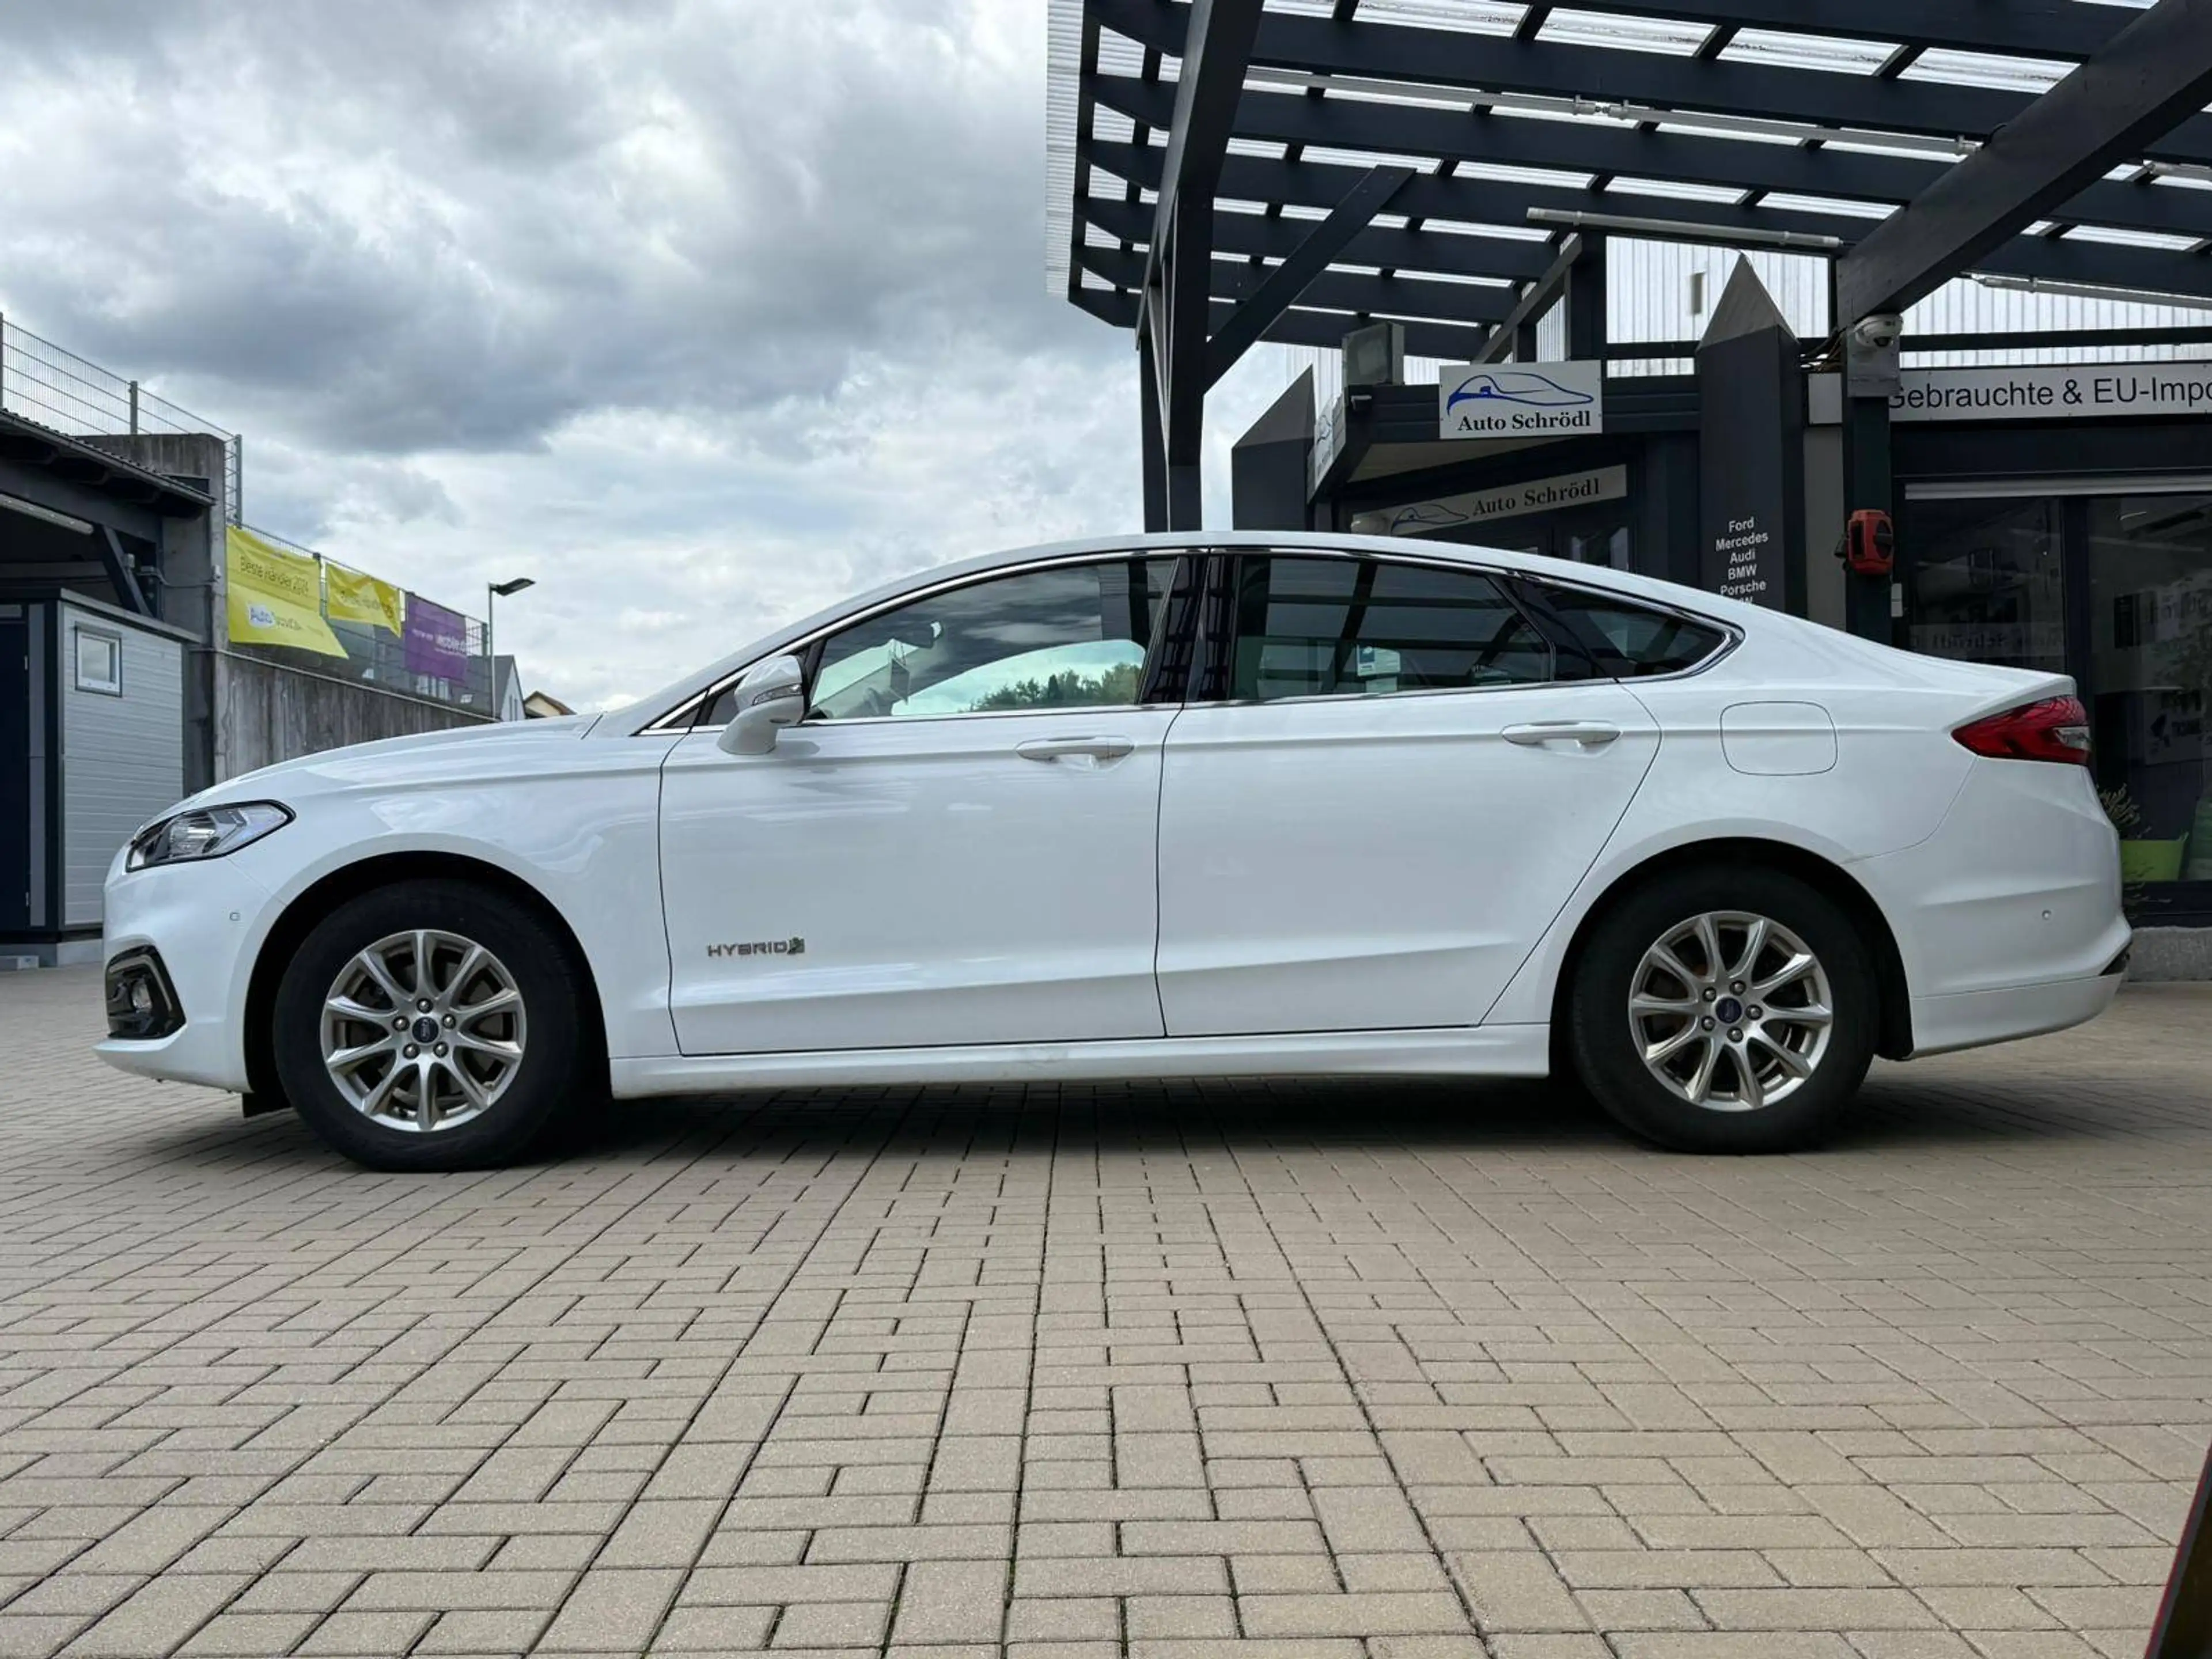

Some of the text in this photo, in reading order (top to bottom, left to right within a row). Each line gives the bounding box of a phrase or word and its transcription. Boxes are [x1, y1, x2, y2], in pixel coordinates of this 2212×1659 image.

[2062, 378, 2084, 406] &
[1457, 410, 1591, 431] Auto Schrödl
[1472, 477, 1601, 516] Auto Schrödl
[1729, 517, 1755, 533] Ford
[1715, 532, 1769, 552] Mercedes
[1729, 548, 1756, 565] Audi
[1728, 564, 1757, 581] BMW
[1720, 579, 1767, 596] Porsche
[707, 941, 787, 957] HYBRID
